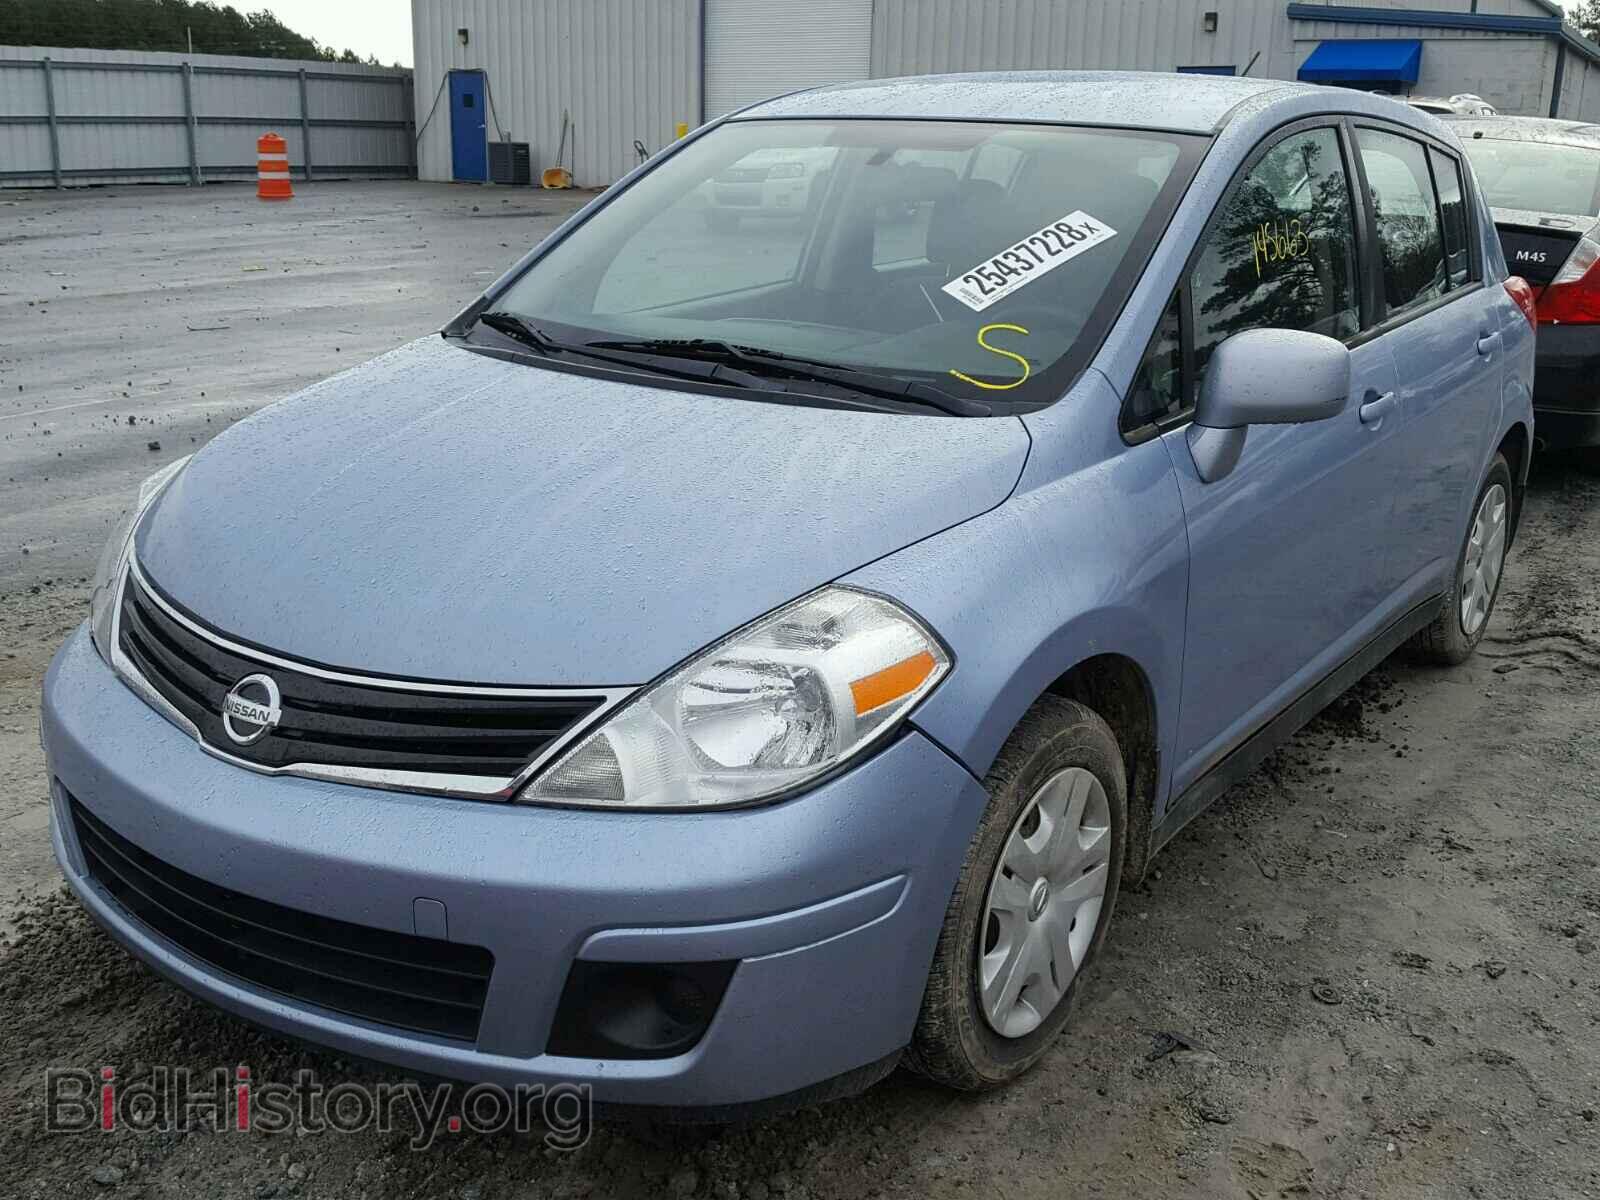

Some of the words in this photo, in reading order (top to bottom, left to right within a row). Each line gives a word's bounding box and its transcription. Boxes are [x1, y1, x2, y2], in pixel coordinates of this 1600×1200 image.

[1516, 250, 1548, 263] M45
[950, 324, 1030, 390] S
[224, 696, 271, 722] NISSAN
